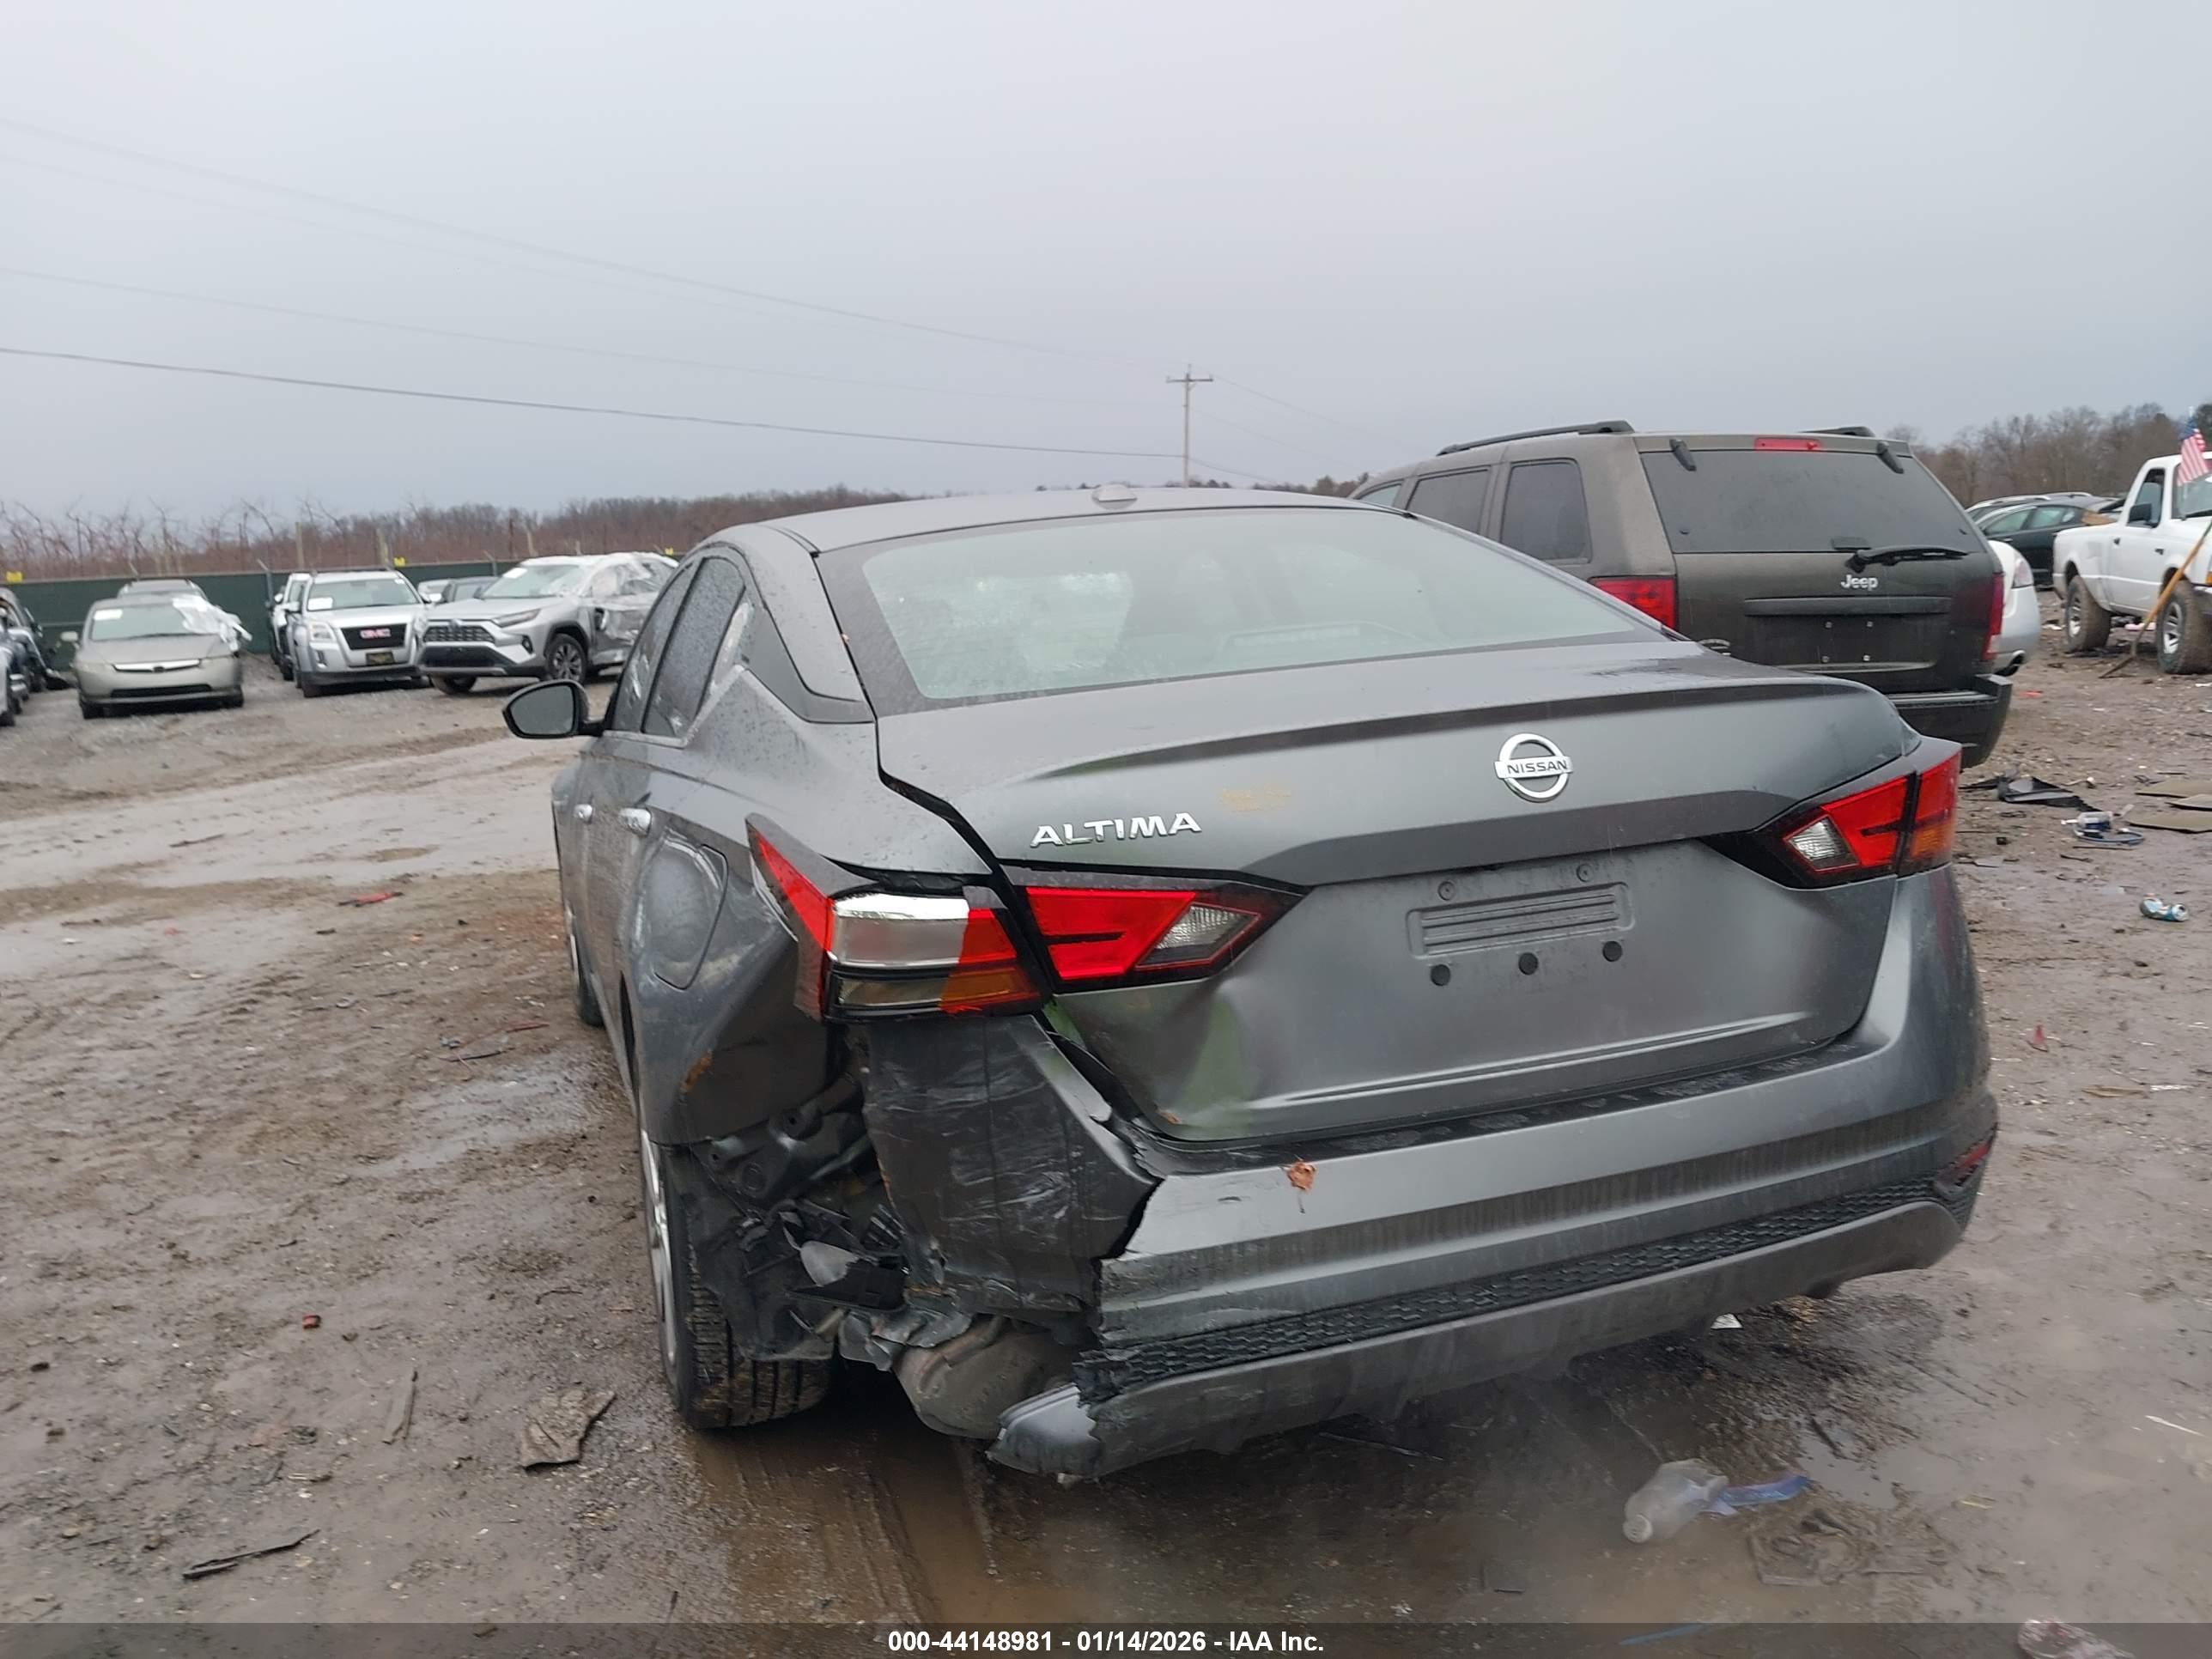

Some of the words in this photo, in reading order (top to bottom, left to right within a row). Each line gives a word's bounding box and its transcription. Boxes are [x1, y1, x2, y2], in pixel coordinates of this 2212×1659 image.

[1840, 574, 1878, 591] Jeep
[360, 629, 392, 638] GMC
[1507, 760, 1568, 775] NISSAN
[1030, 812, 1202, 848] ALTIMA
